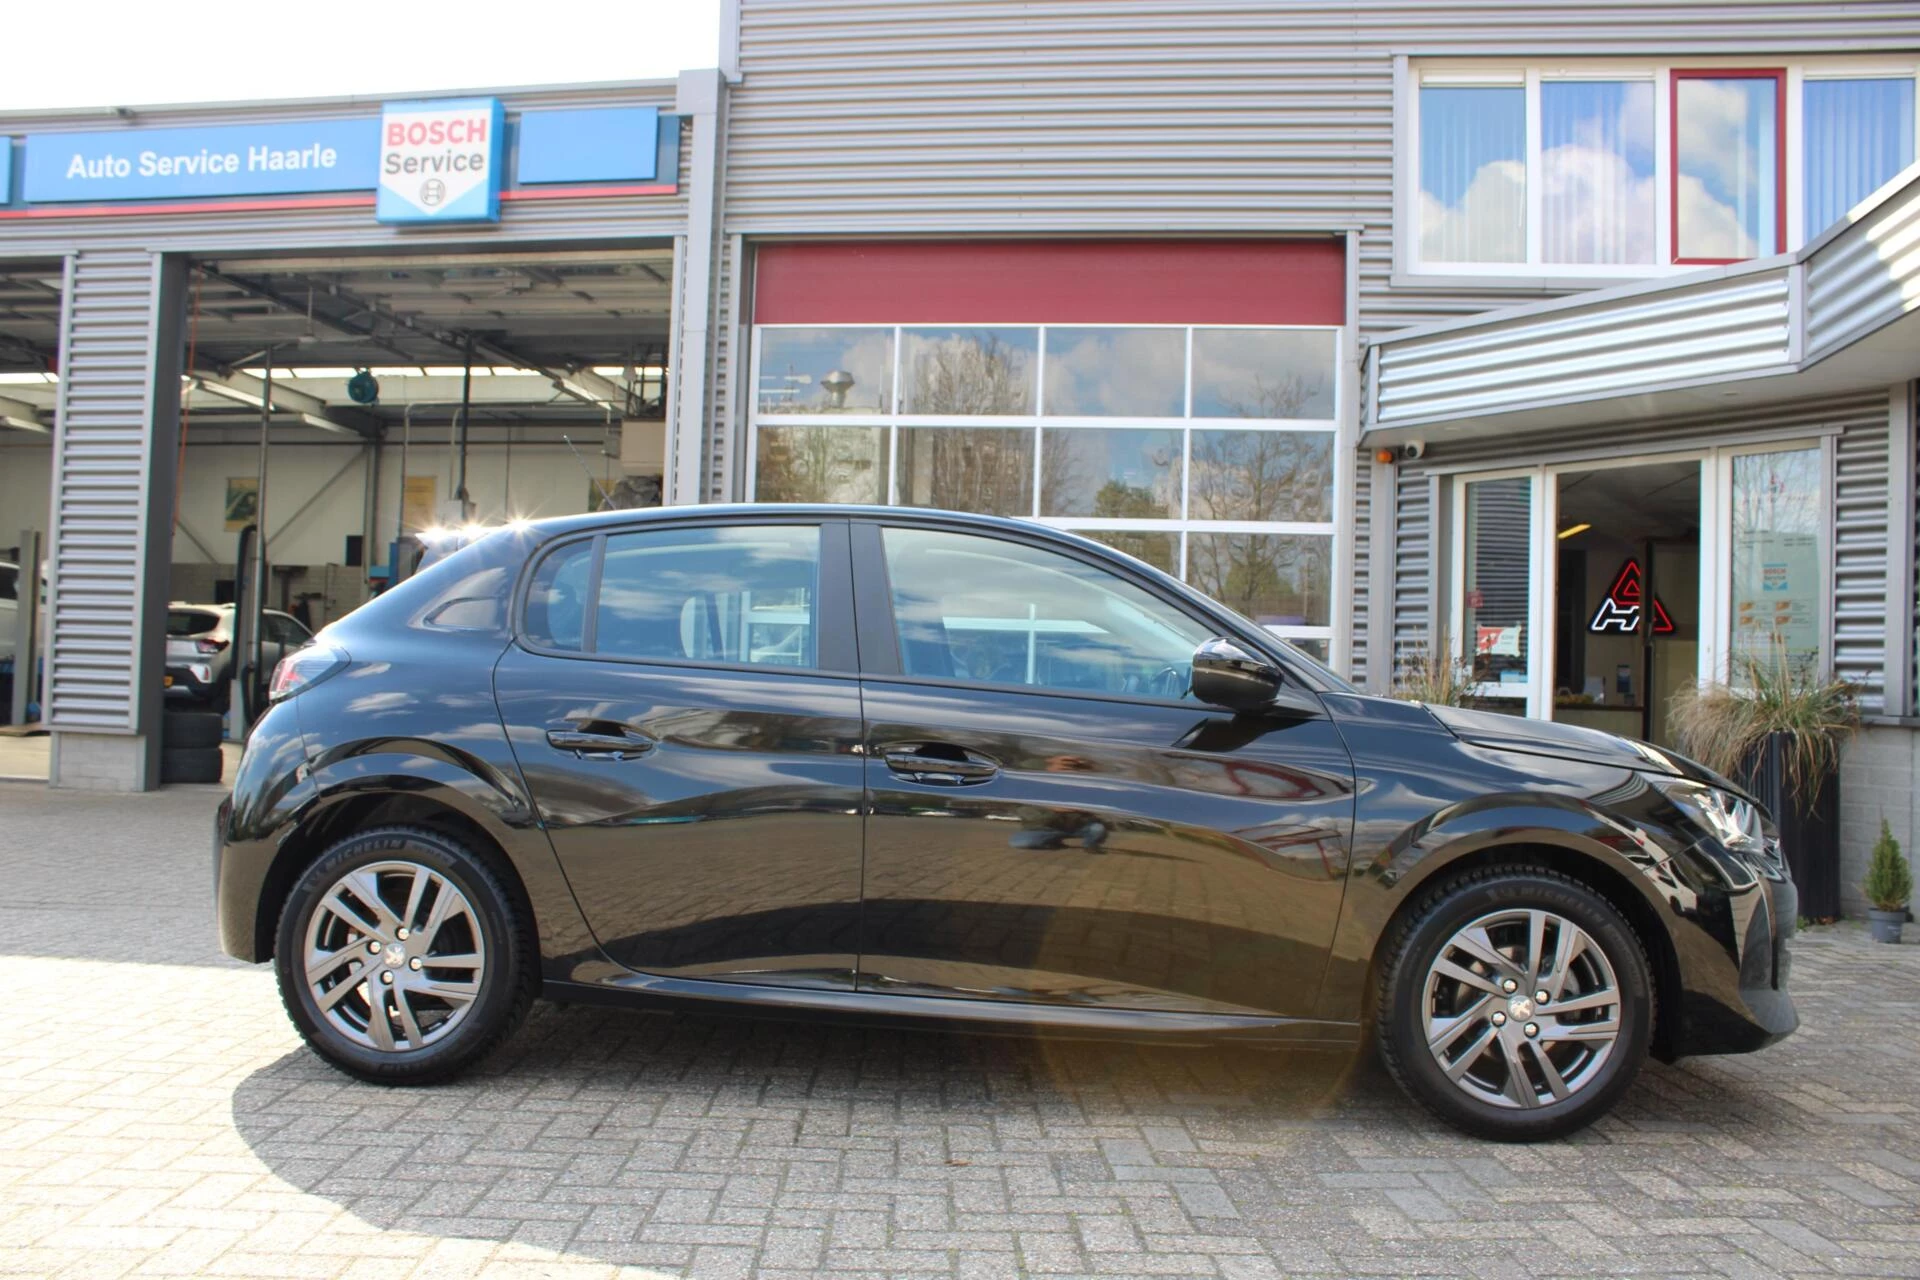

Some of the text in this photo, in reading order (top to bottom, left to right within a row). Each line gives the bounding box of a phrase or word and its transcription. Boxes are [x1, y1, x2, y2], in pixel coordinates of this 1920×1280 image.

[387, 119, 488, 146] BOSCH
[66, 143, 337, 179] Auto Service Haarle
[385, 149, 485, 175] Service
